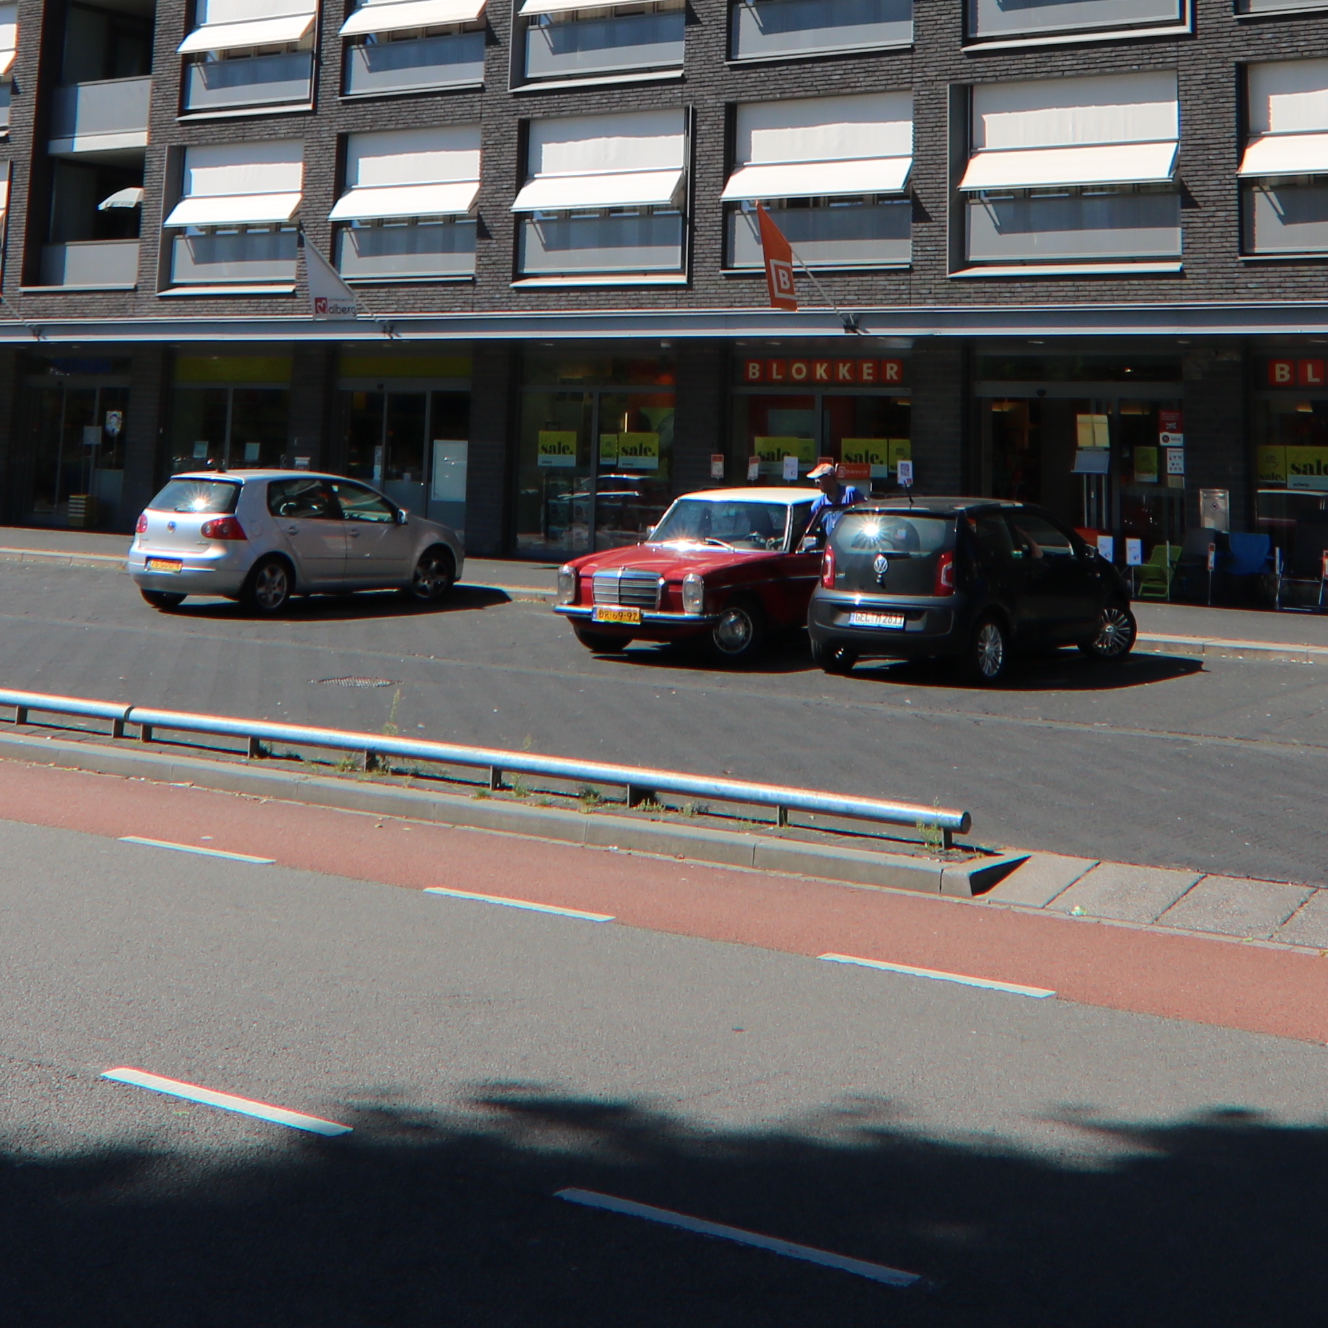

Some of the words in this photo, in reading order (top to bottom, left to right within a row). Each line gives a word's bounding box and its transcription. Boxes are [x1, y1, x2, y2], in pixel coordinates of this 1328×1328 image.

[779, 269, 791, 290] B
[748, 362, 899, 380] BLOKKER
[540, 441, 574, 455] sale.
[620, 443, 656, 457] sale.
[844, 449, 884, 465] sale.
